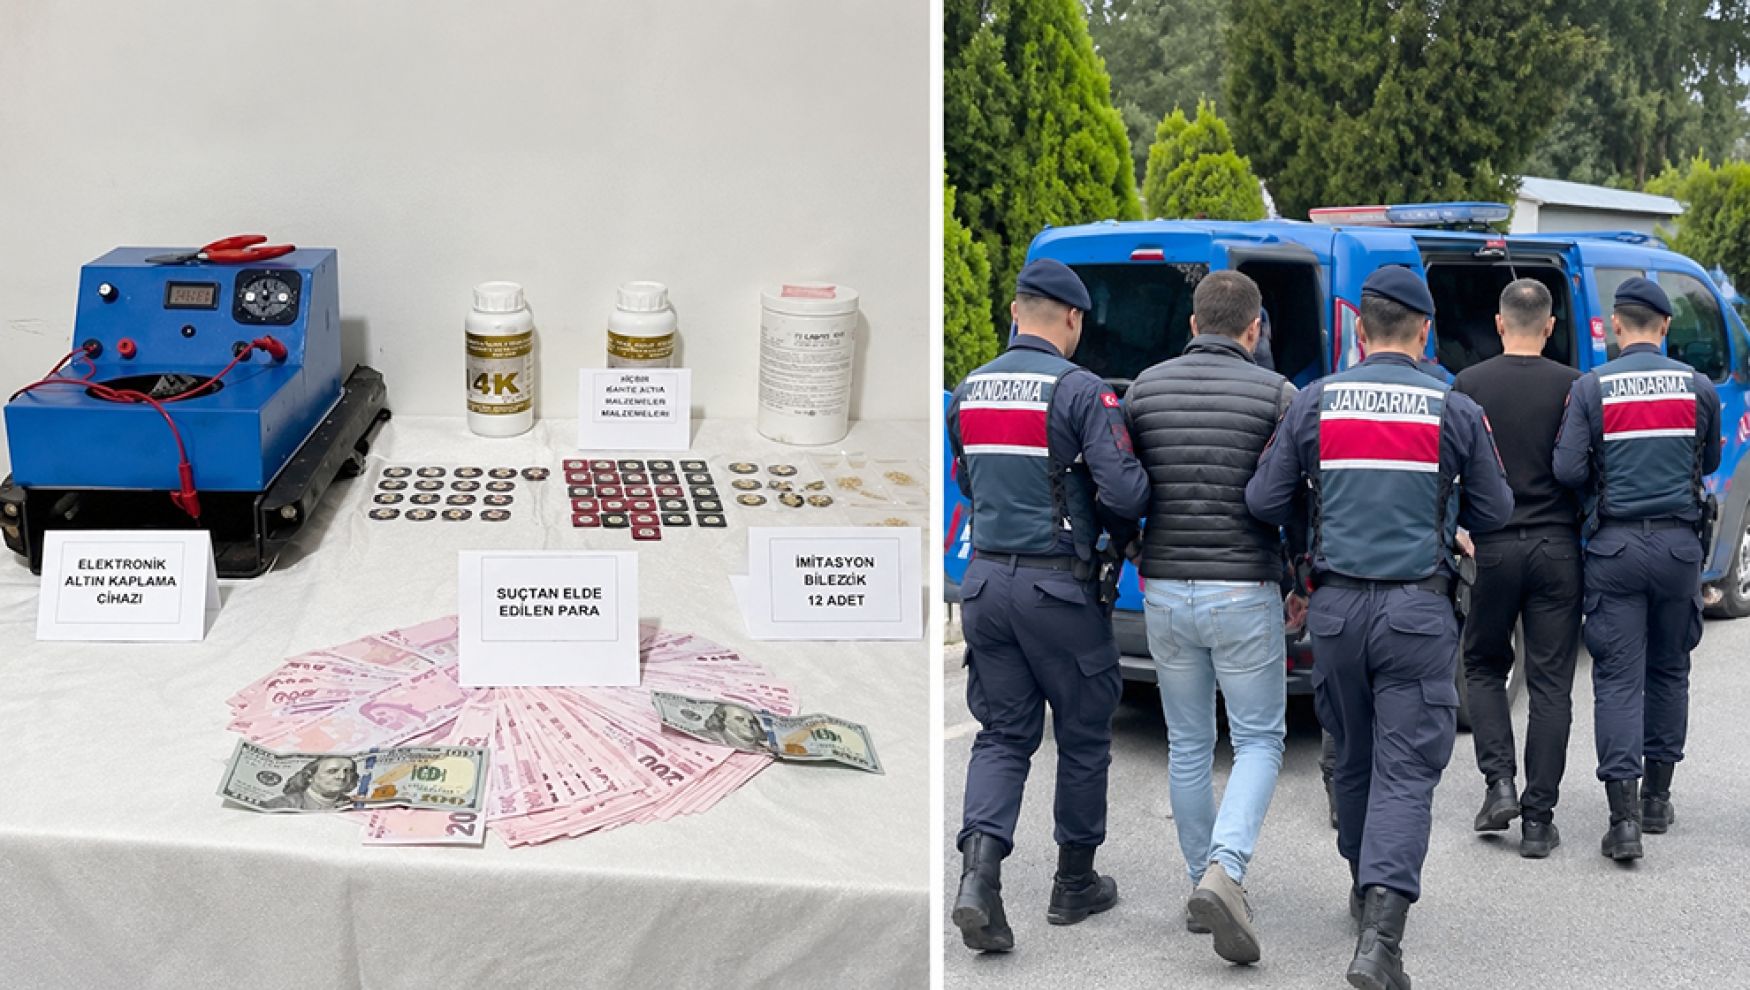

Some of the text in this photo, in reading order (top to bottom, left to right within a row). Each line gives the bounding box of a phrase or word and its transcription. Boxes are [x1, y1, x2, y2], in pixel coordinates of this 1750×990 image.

[966, 379, 1042, 402] JANDARMA
[1609, 375, 1688, 398] JANDARMA
[1330, 388, 1430, 415] JANDARMA
[78, 556, 167, 570] ELEKTRONİK
[795, 554, 875, 568] İMİTASYON
[64, 575, 178, 587] ALTIN KAPLAMA
[496, 587, 602, 602] SUÇTAN ELDE
[807, 594, 865, 606] 12 ADET
[499, 601, 600, 617] EDİLEN PARA
